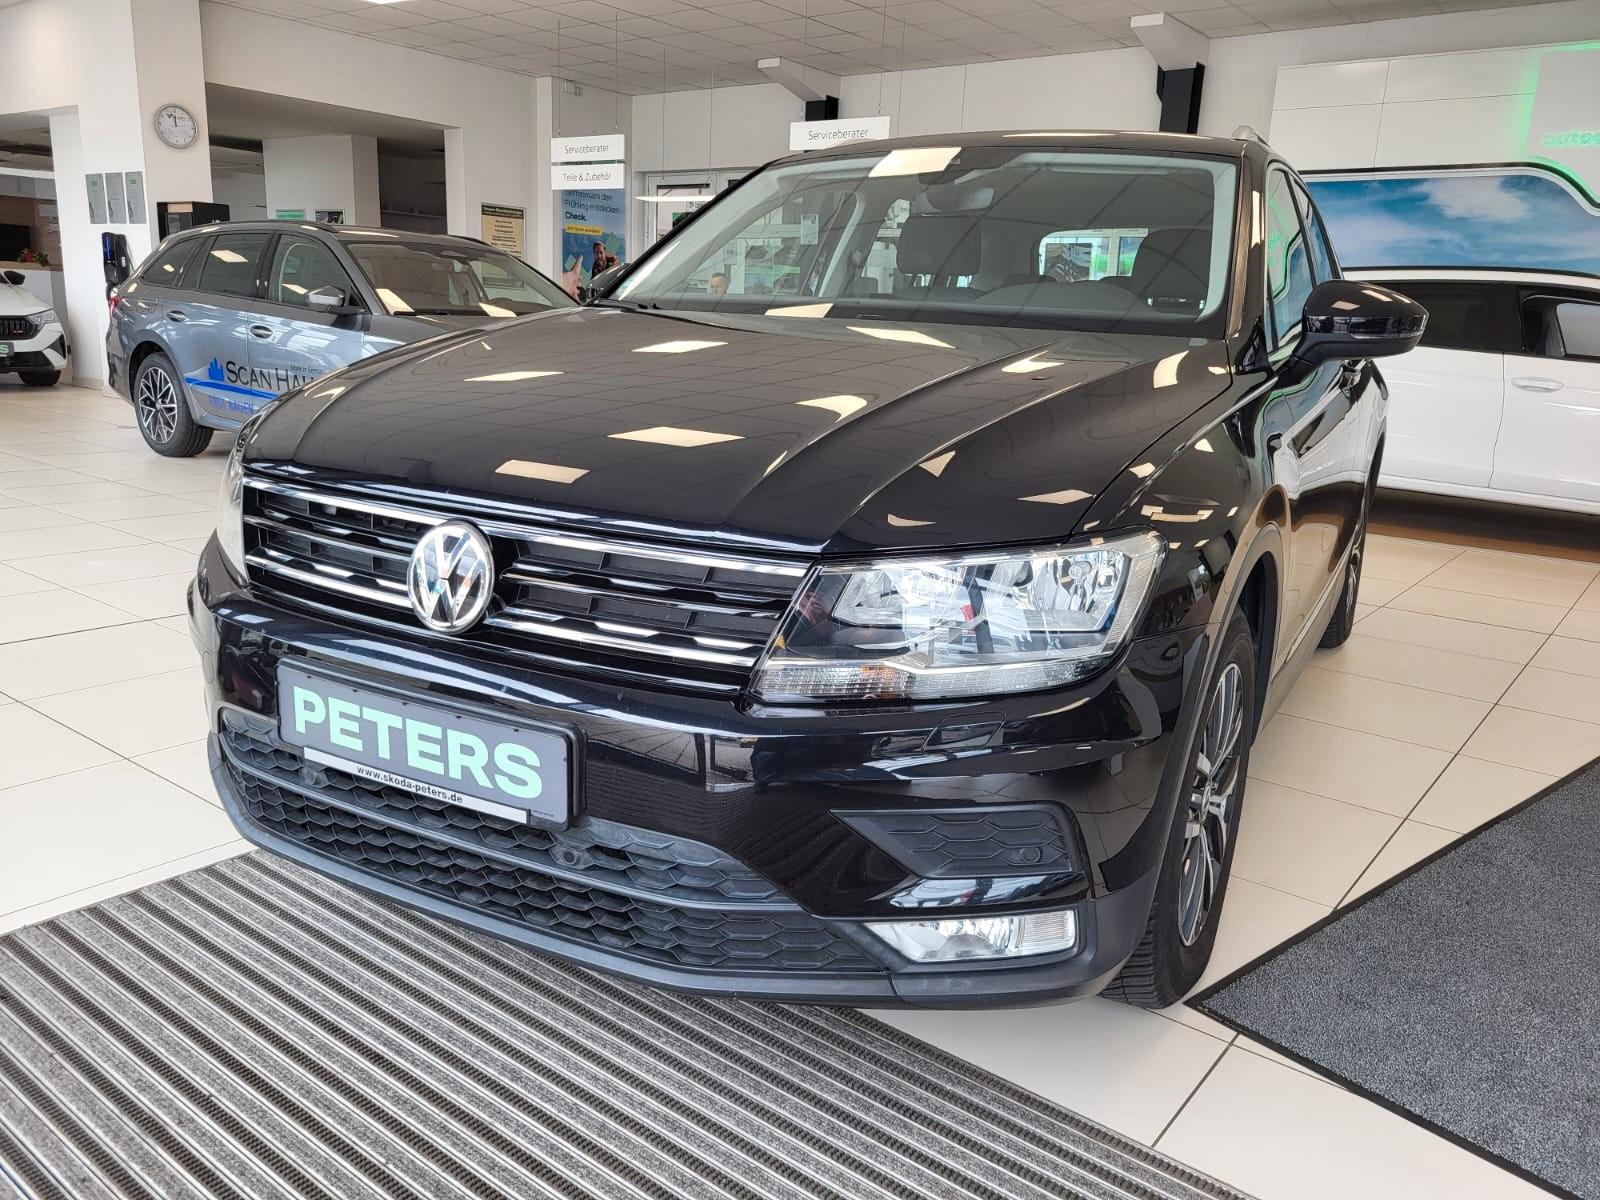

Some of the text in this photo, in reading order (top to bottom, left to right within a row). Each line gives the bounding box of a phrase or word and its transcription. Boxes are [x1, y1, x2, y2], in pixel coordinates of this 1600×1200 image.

[808, 129, 869, 140] Serviceberater
[564, 145, 609, 154] Serviceberater
[562, 172, 611, 182] Teile & Zubehör
[565, 200, 588, 211] Frühling
[565, 211, 587, 221] Check.
[293, 686, 543, 799] PETERS
[357, 766, 463, 803] www.skoda-peters.de
